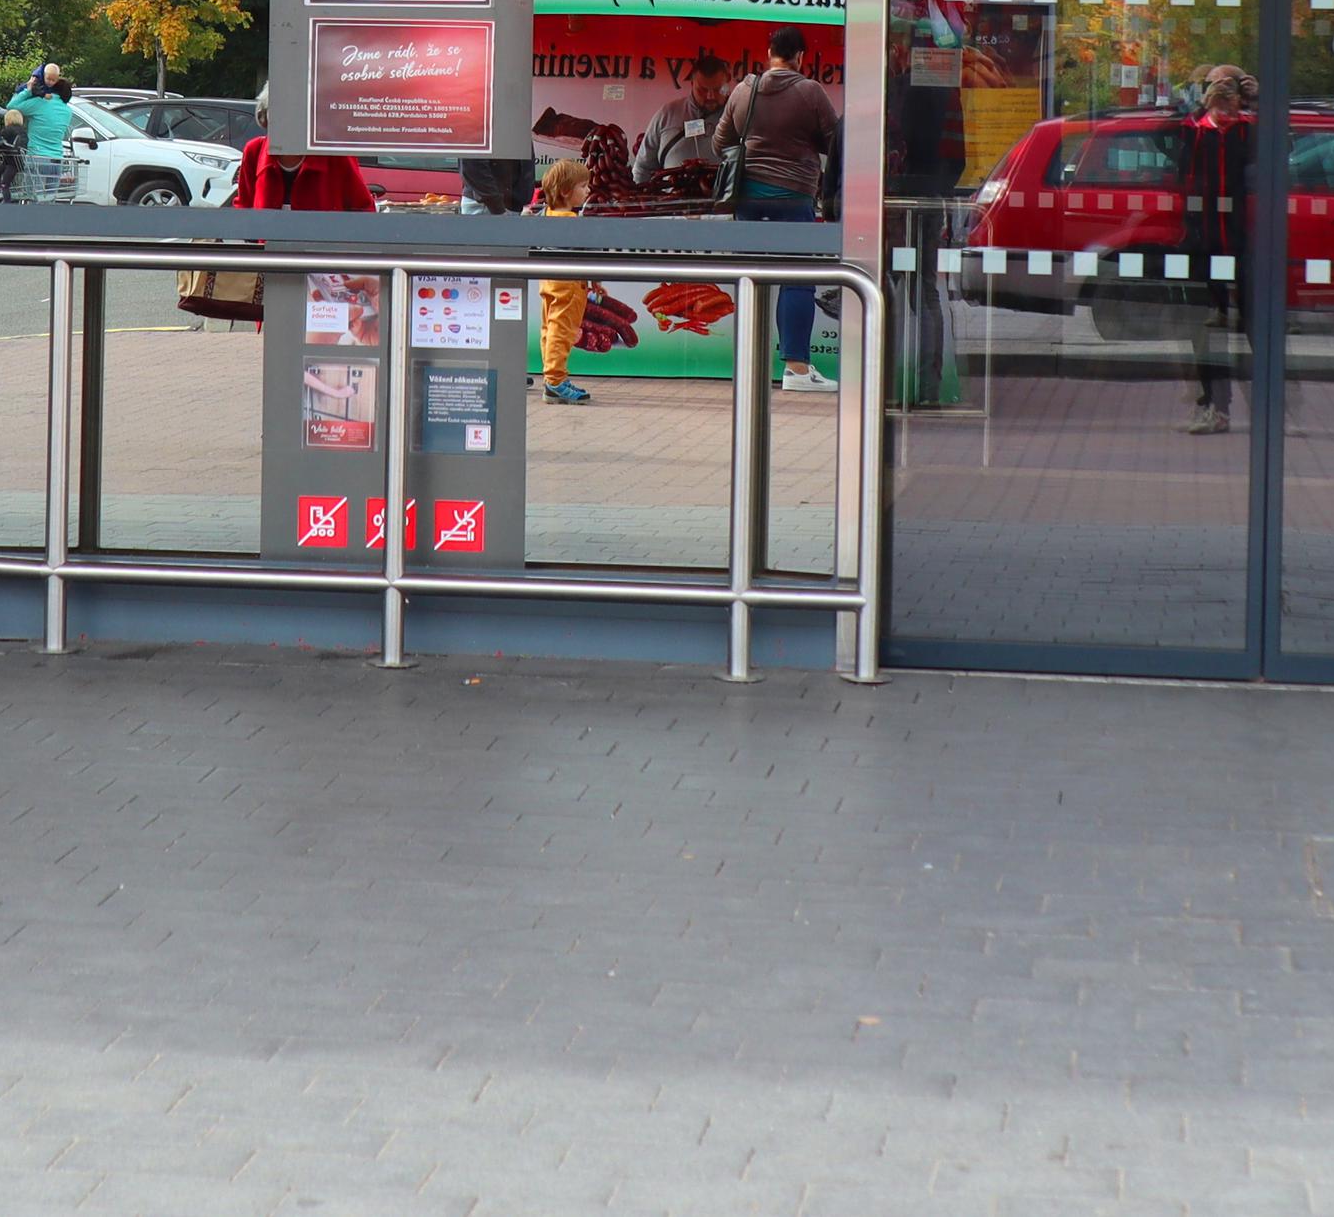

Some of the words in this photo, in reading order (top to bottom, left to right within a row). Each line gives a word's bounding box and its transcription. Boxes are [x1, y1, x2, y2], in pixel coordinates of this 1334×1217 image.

[342, 45, 382, 67] Jsme
[426, 44, 441, 58] že
[447, 47, 462, 56] se
[340, 66, 385, 82] osobně
[390, 58, 463, 81] setkáváme!
